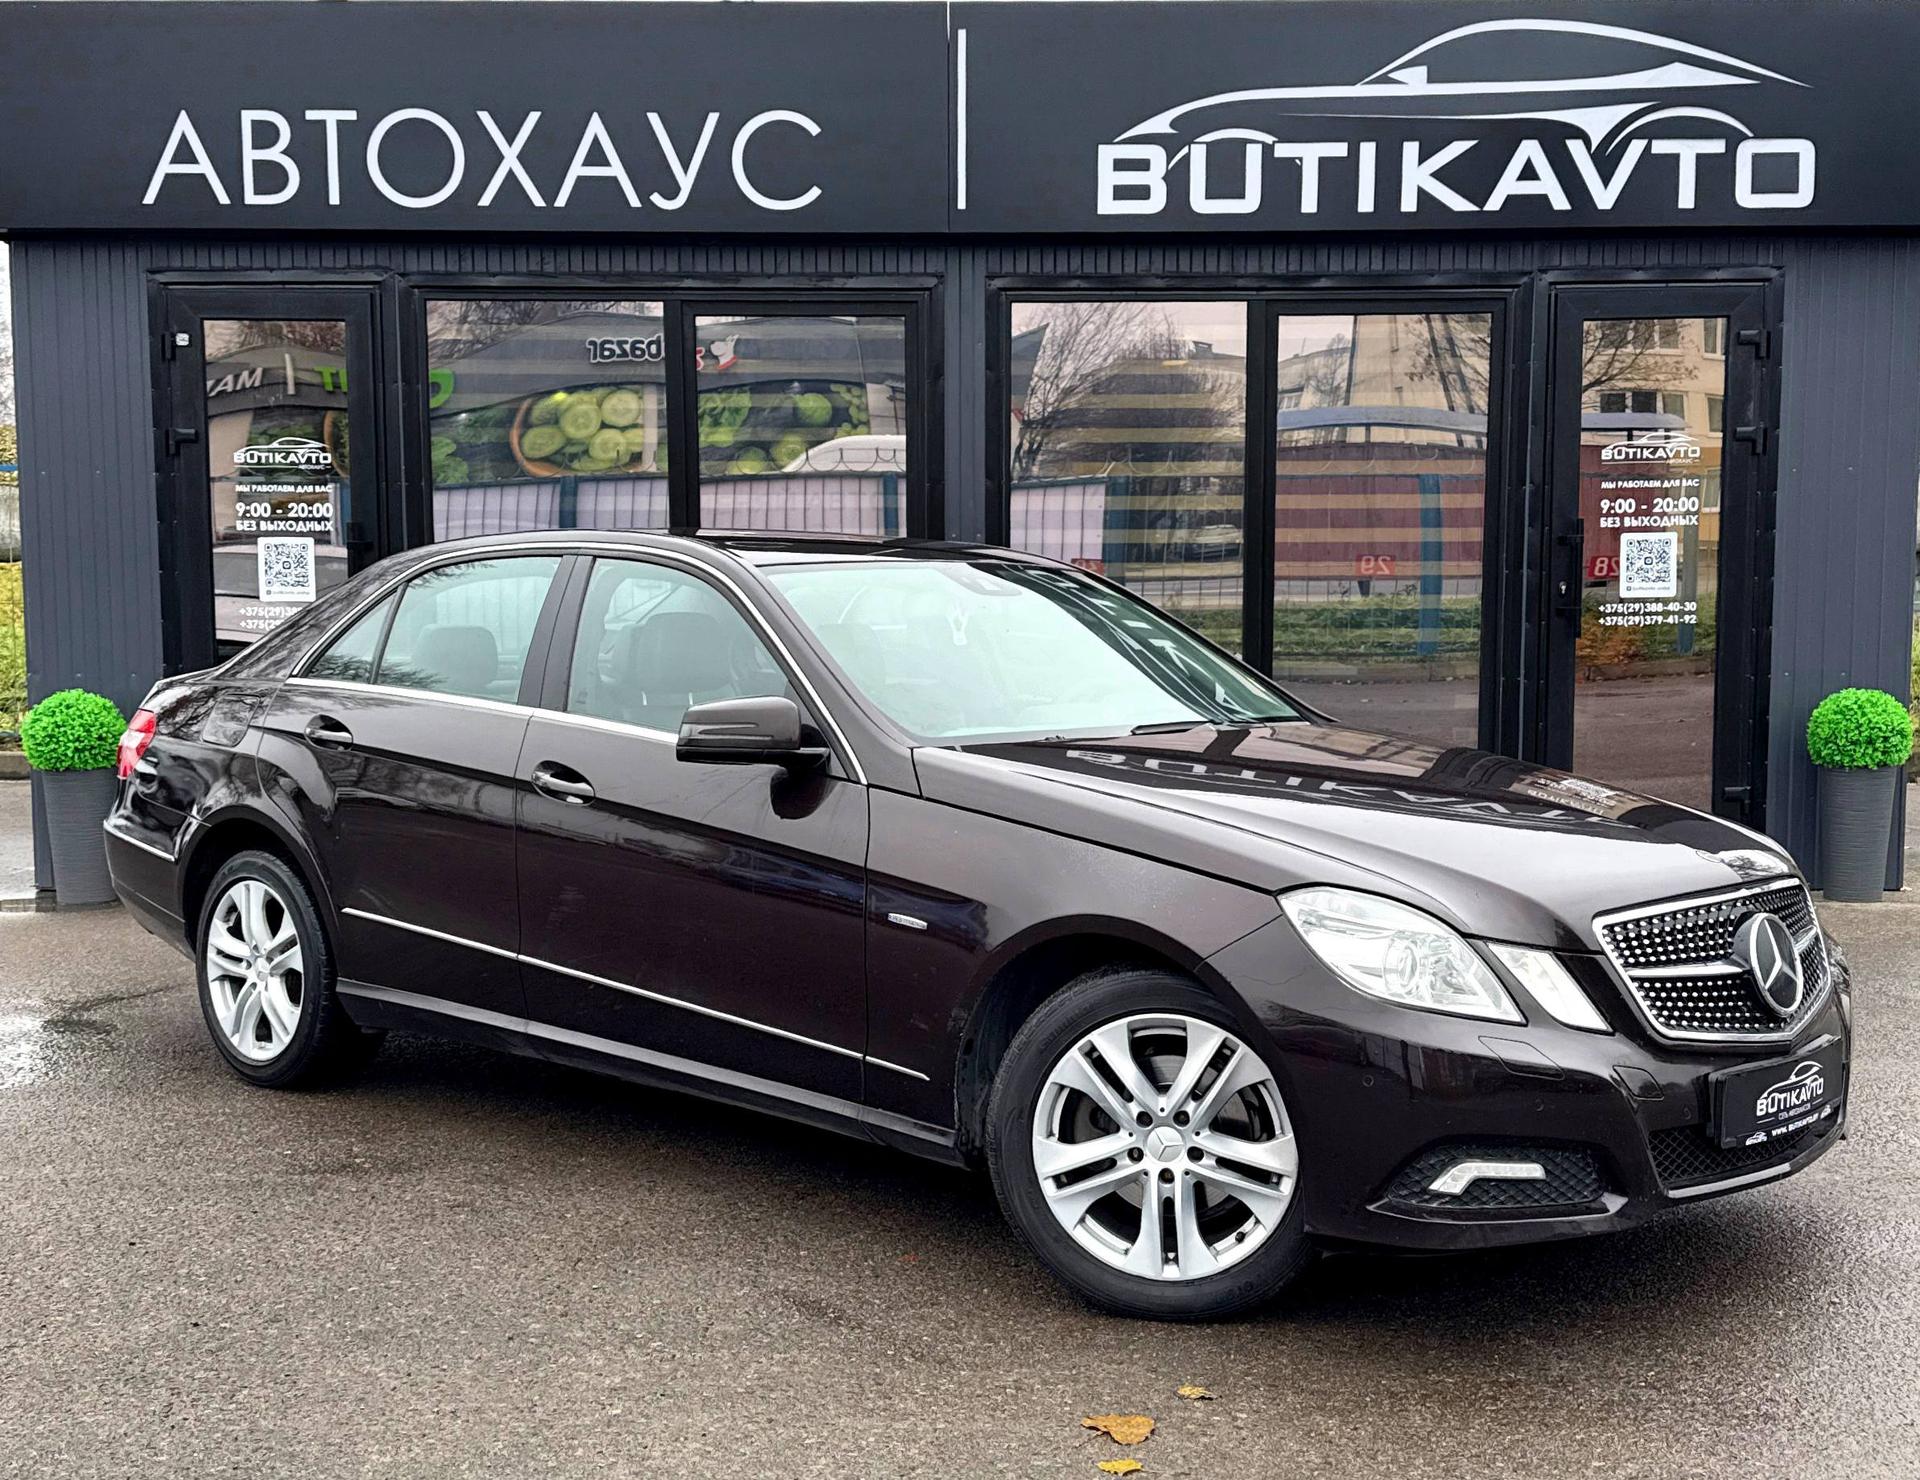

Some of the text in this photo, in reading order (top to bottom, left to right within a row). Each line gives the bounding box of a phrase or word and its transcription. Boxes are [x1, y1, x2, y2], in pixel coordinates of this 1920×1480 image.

[142, 108, 823, 211] АВТОХАУС
[1097, 139, 1816, 215] BUTIKAVTO
[233, 452, 332, 464] BUTIKAVTO
[1601, 446, 1700, 460] BUTIKAVTO
[251, 485, 295, 493] РАБОТАЕМ
[296, 485, 314, 493] ДЛЯ
[315, 485, 333, 493] ВАС
[1601, 479, 1700, 489] МЫ РАБОТАЕМ ДЛЯ ВАС
[235, 502, 271, 518] 9:00
[287, 502, 334, 518] 20:00
[1600, 498, 1636, 514] 9:00
[1652, 497, 1699, 513] 20:00
[236, 519, 334, 533] БЕЗ ВЫХОДНЫХ
[1600, 515, 1699, 528] БЕЗ ВЫХОДНЫХ
[1598, 602, 1697, 614] +375(29)388-40-30
[1598, 615, 1697, 627] +375(29)379-41-92
[1757, 1077, 1824, 1117] BUTIKAVTO
